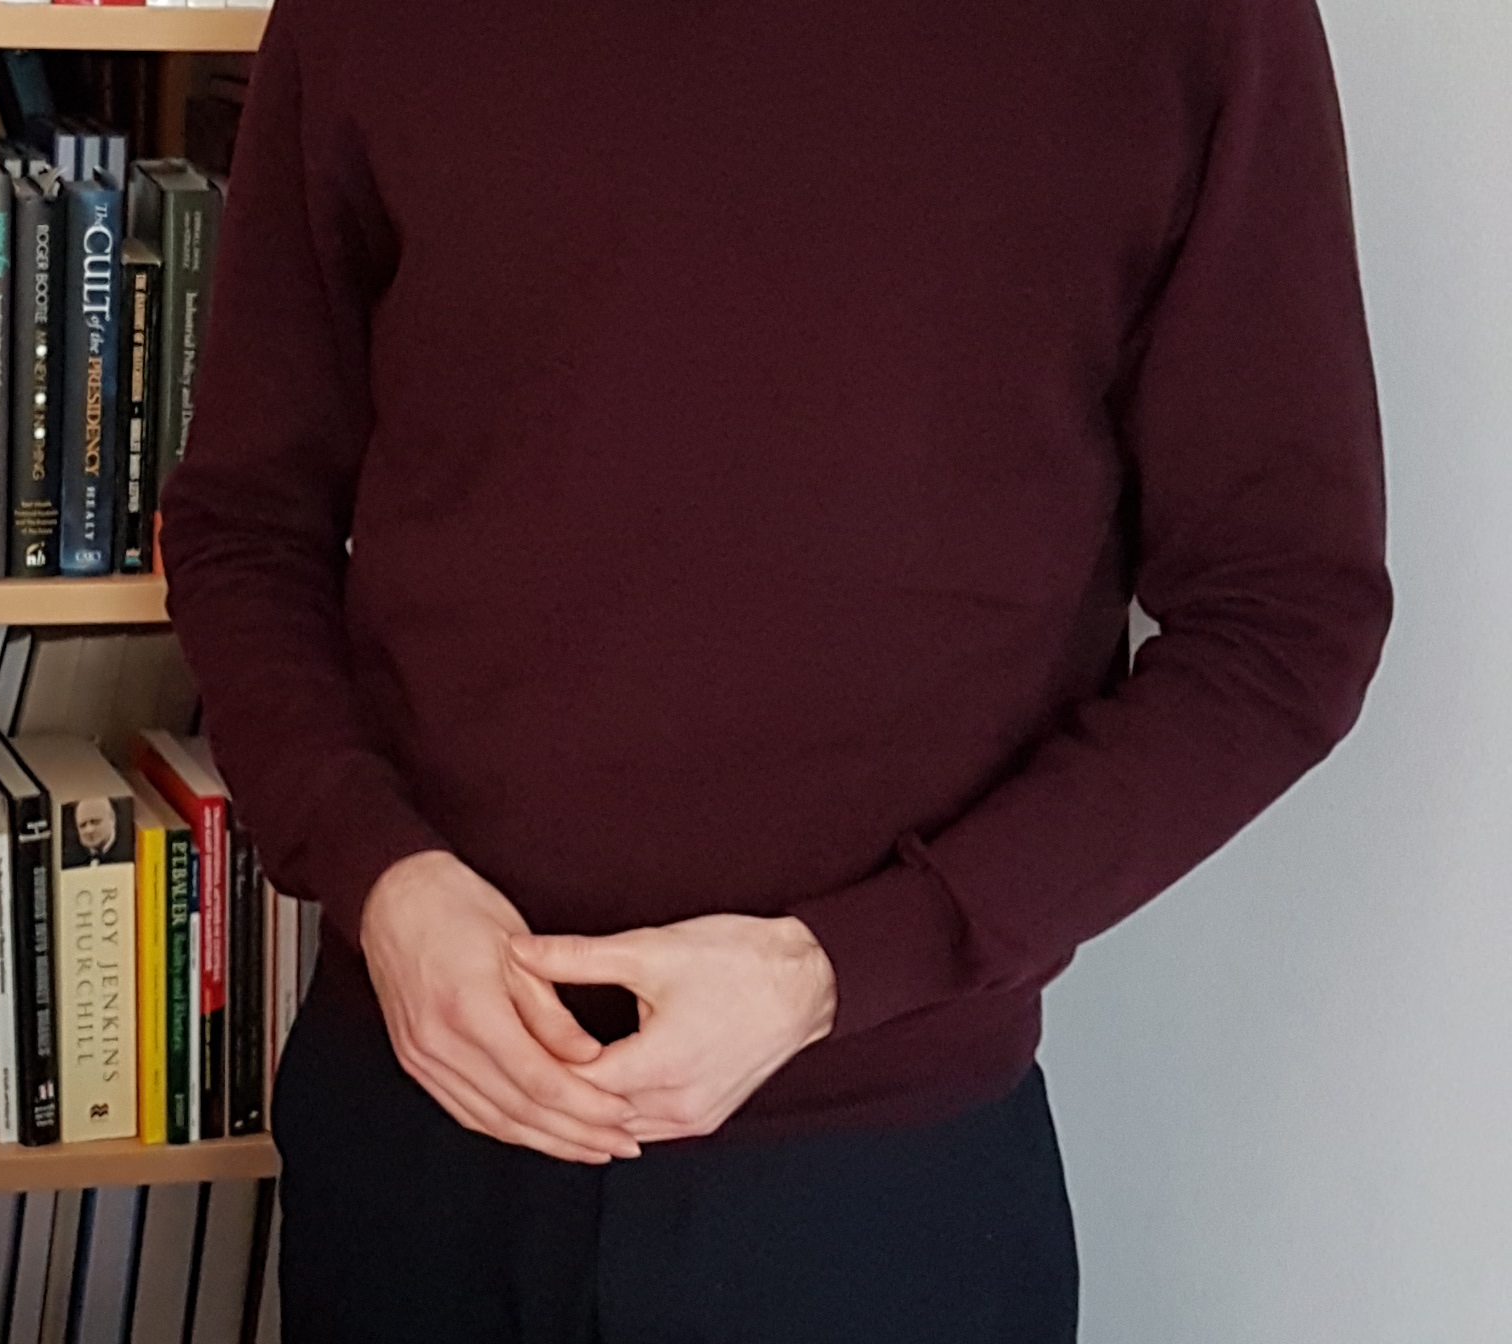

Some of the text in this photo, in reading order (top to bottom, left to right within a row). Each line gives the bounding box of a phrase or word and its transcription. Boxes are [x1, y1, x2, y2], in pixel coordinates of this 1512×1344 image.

[34, 224, 49, 323] ROGER BOOTLE
[82, 203, 113, 477] The CULT of the PRESIDENCY
[83, 486, 96, 540] HEALY
[77, 891, 94, 1066] CHURCHILL
[100, 888, 119, 1083] ROY JENKINS
